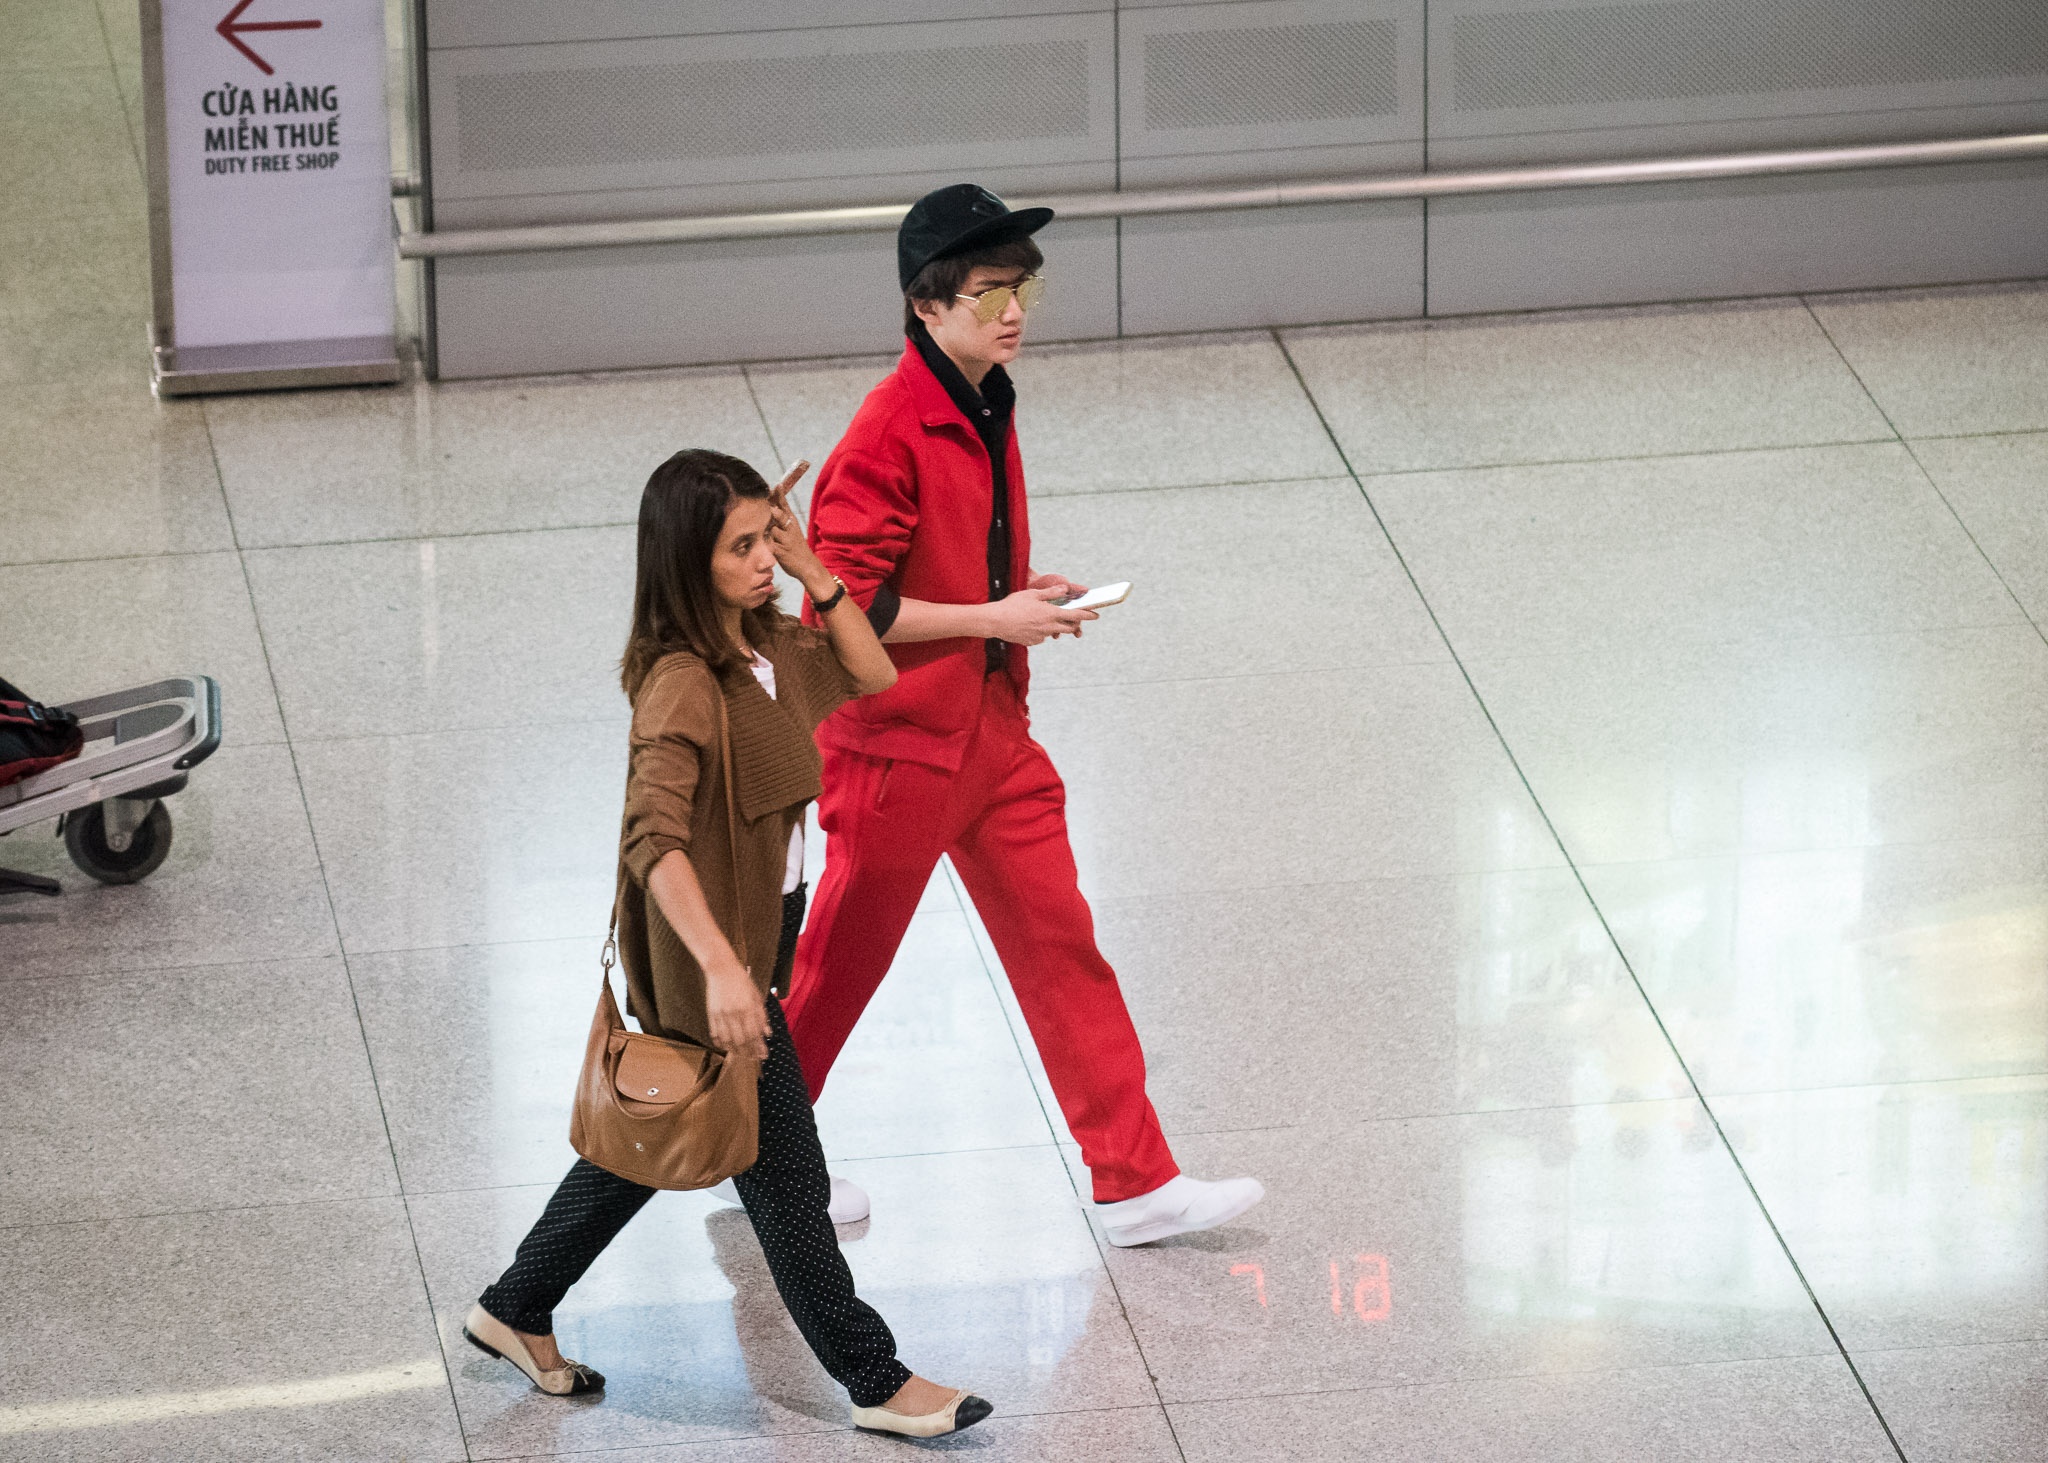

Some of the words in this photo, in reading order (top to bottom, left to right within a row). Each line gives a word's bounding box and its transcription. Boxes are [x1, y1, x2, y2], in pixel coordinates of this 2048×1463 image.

[202, 82, 256, 117] CỬA
[263, 81, 339, 115] HÀNG
[204, 117, 269, 152] MIỄN
[274, 113, 341, 149] THUẾ
[204, 156, 247, 175] DUTY
[251, 155, 291, 173] FREE
[295, 151, 340, 171] SHOP
